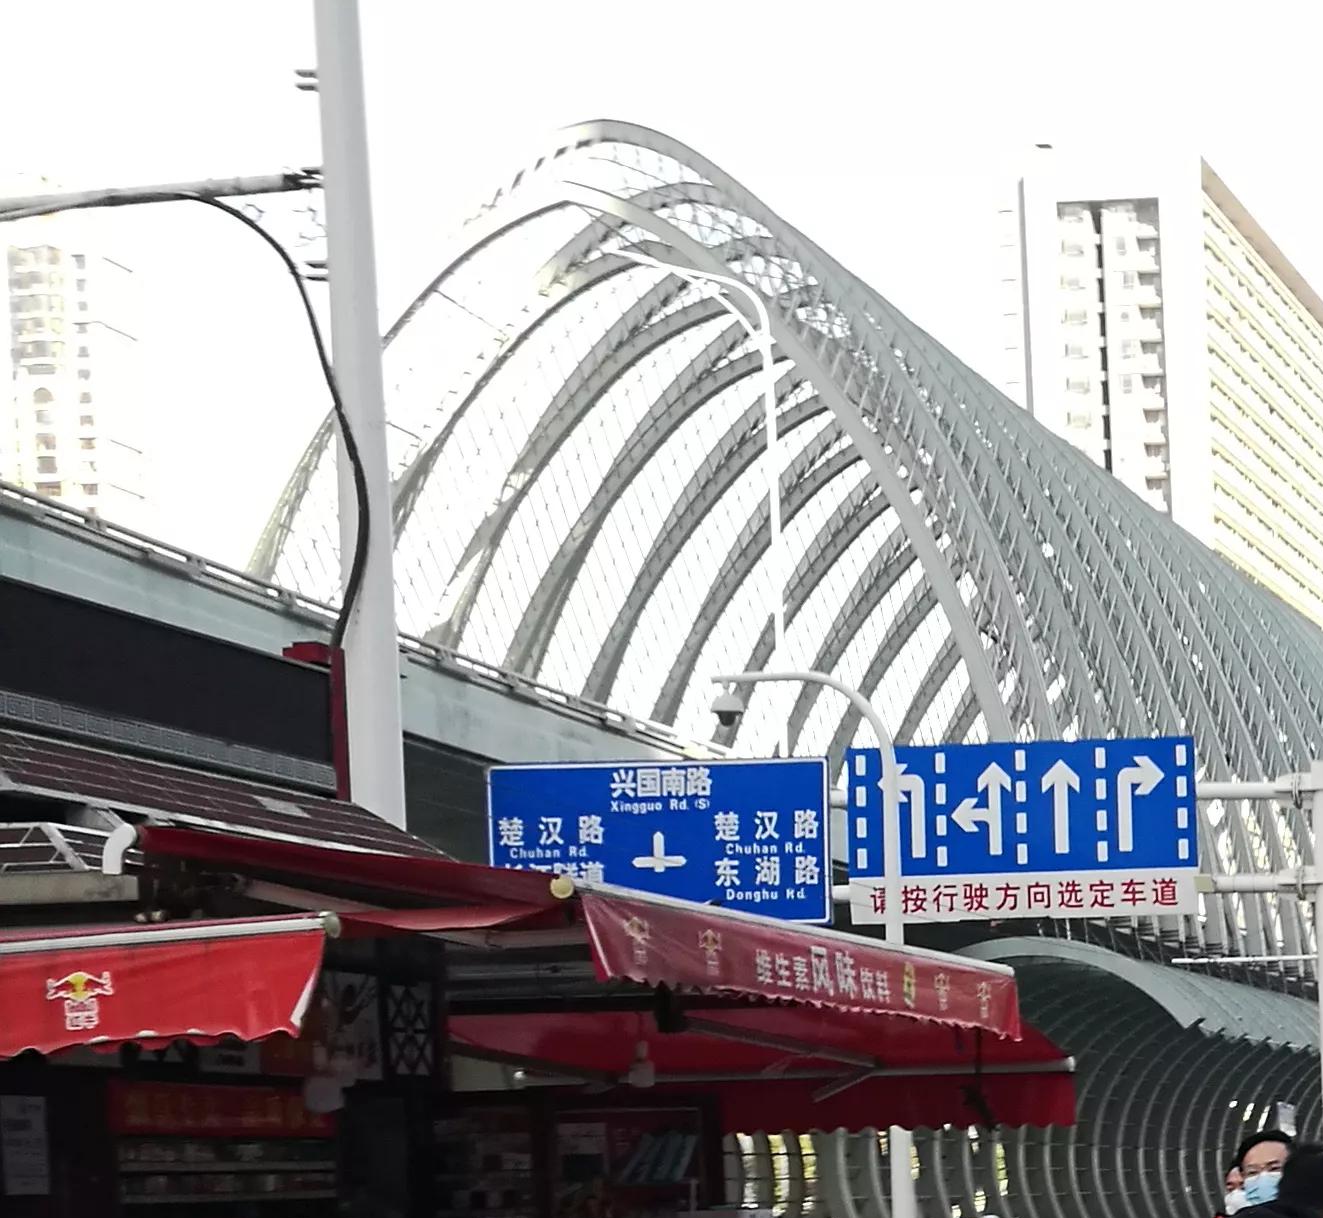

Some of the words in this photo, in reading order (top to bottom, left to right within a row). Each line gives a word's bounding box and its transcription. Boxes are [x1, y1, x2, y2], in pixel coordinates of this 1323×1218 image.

[610, 767, 712, 798] 兴国南路
[610, 800, 663, 814] Xingguo
[498, 814, 605, 846] 楚汉路
[714, 809, 819, 841] 楚汉路
[509, 847, 561, 859] Chuhan
[725, 843, 778, 855] Chuhan
[714, 855, 820, 887] 东湖路
[726, 888, 779, 902] Donghu
